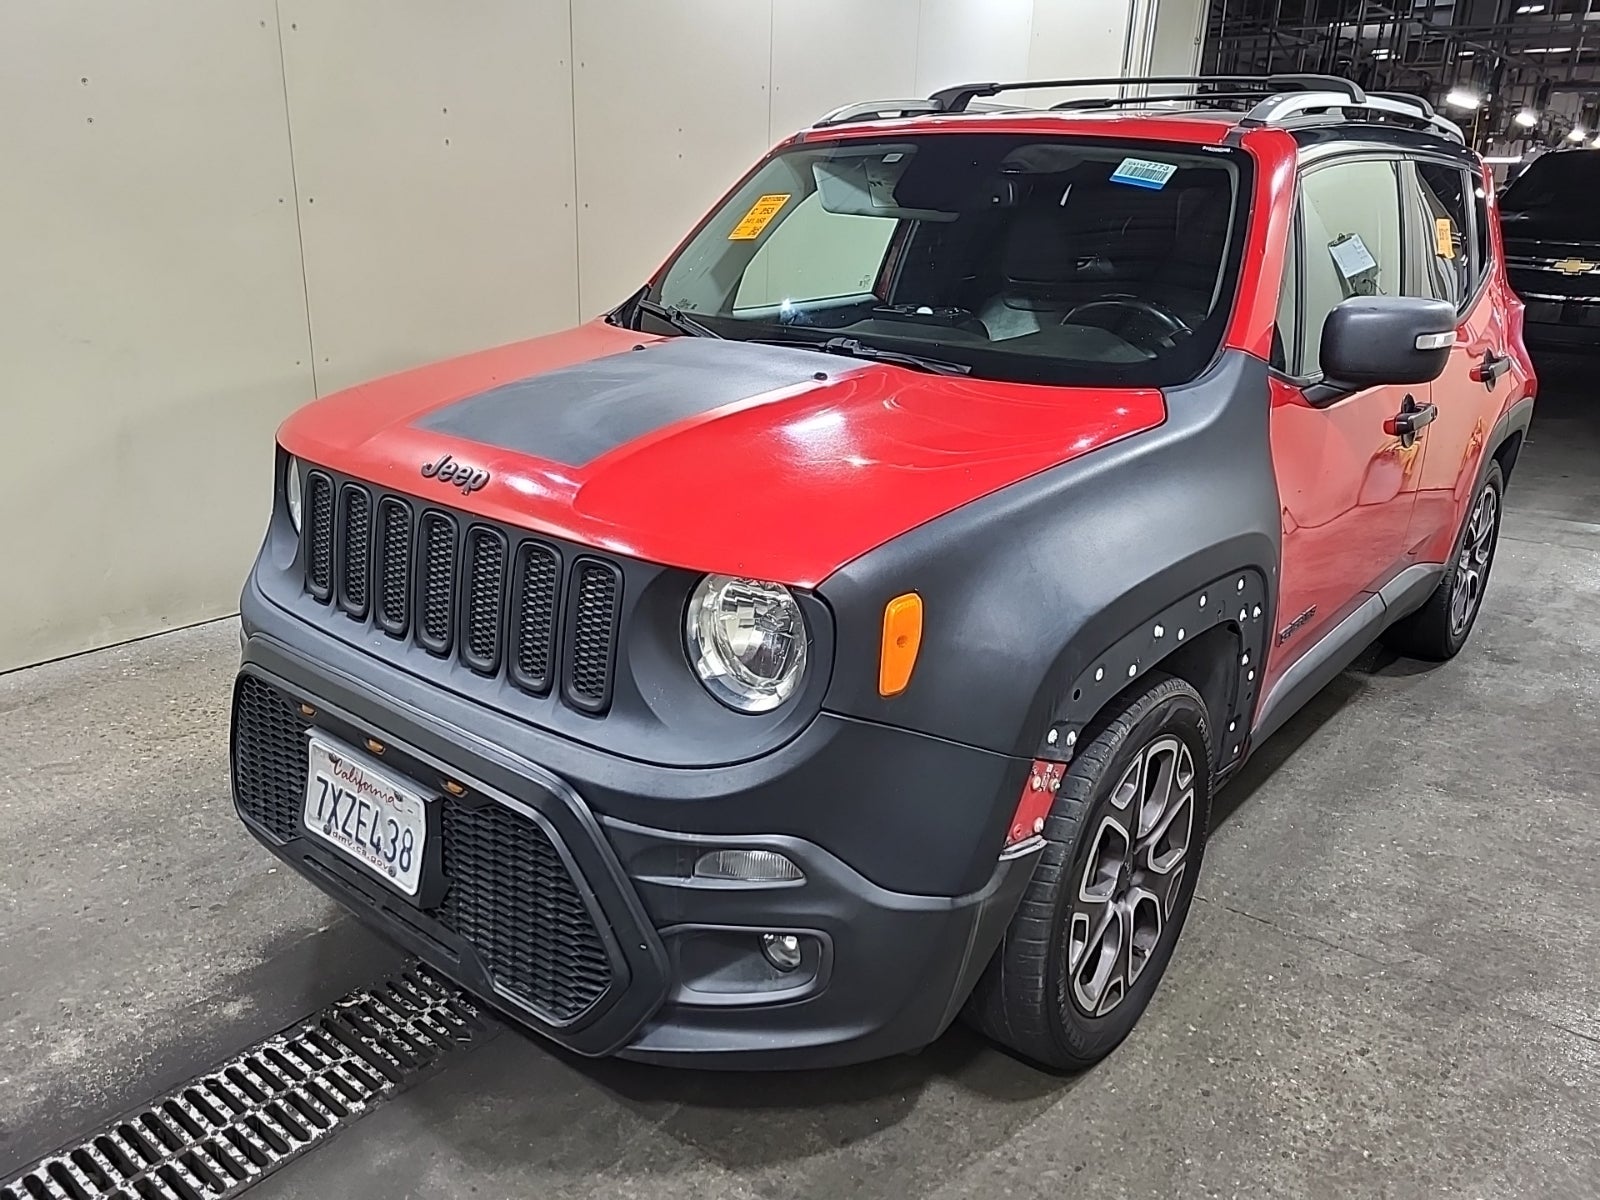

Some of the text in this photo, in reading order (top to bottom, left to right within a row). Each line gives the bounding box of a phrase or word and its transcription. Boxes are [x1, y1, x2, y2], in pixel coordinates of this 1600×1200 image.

[421, 454, 490, 496] Jeep
[329, 758, 402, 813] California
[316, 775, 414, 873] 7XZE438
[331, 830, 389, 870] dmv.ca.gov
